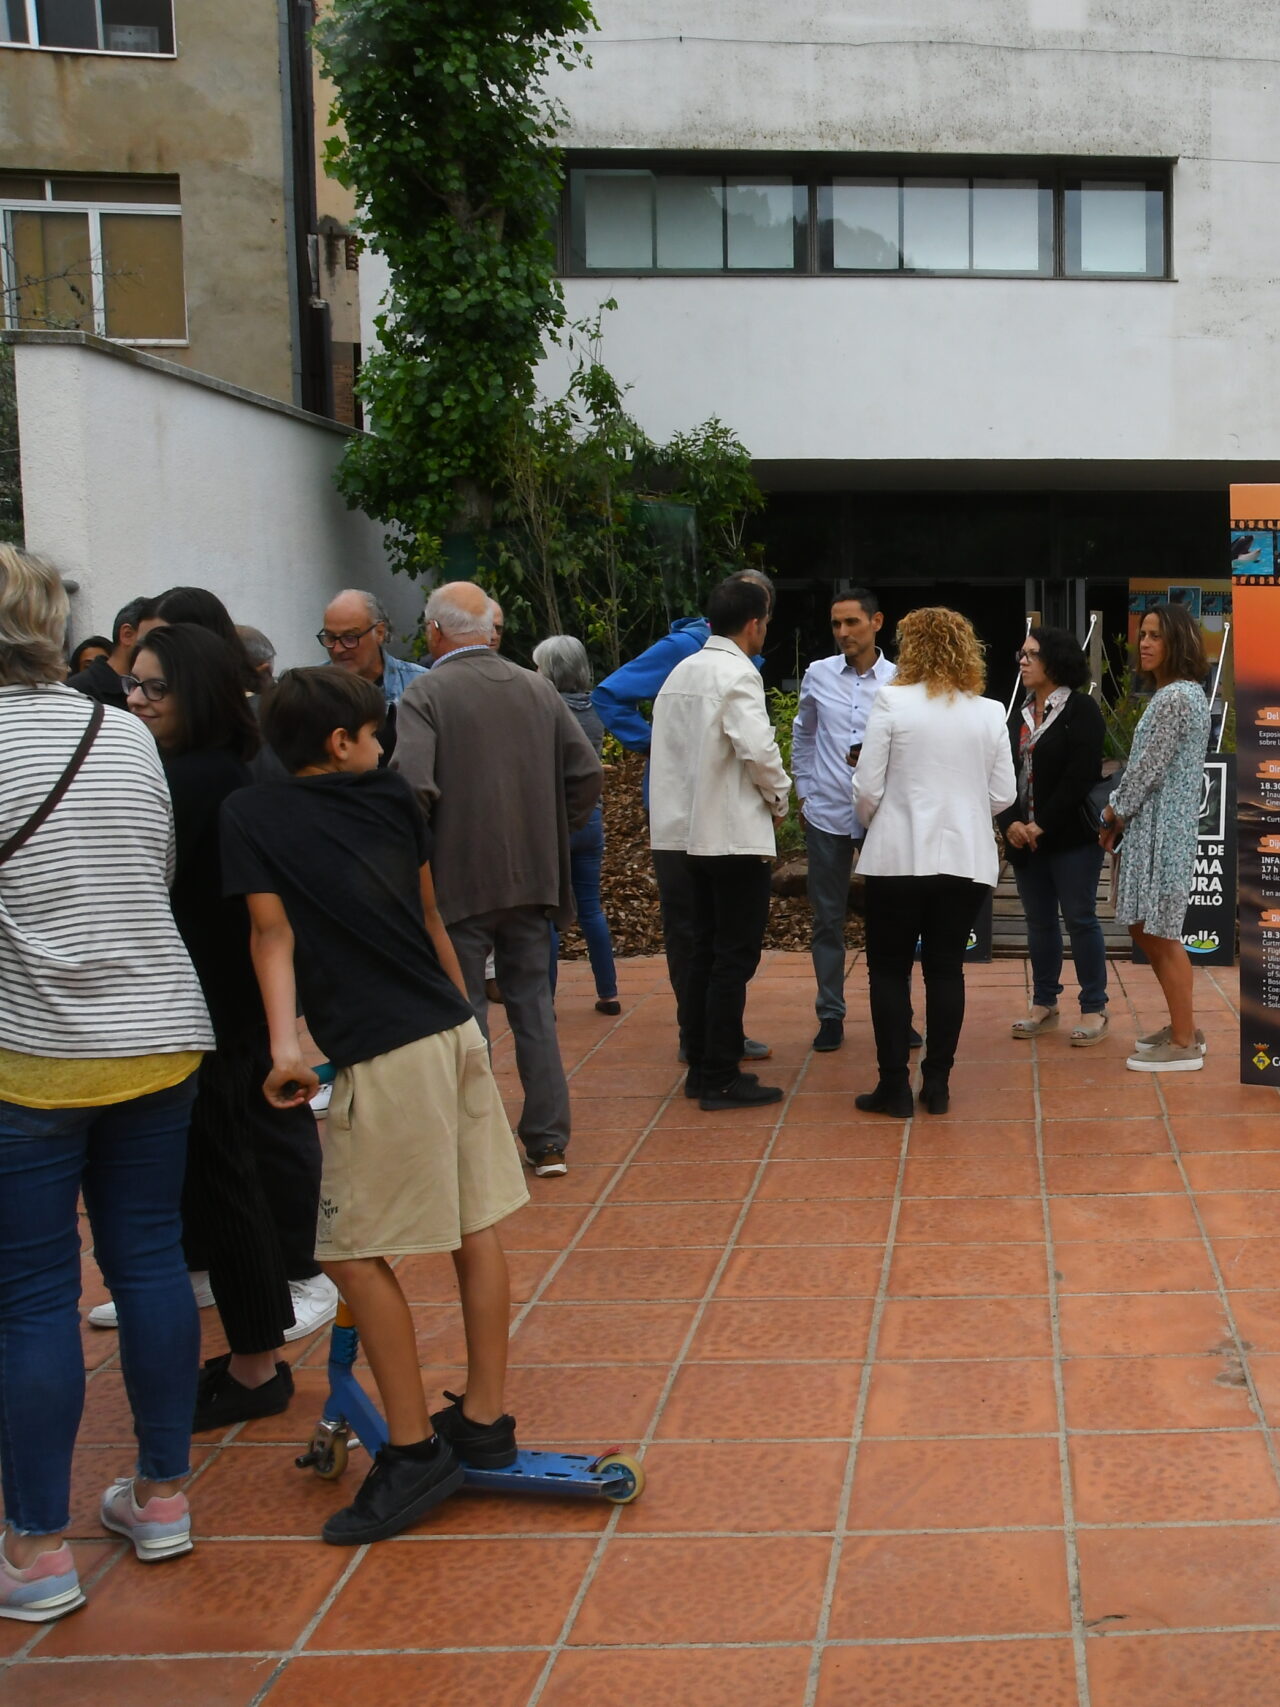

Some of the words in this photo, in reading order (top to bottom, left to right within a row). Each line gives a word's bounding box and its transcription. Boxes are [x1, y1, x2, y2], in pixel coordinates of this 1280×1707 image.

[1267, 712, 1279, 720] Del
[1208, 845, 1224, 856] DE
[1188, 893, 1222, 906] VELLÓ
[1180, 930, 1219, 945] velló
